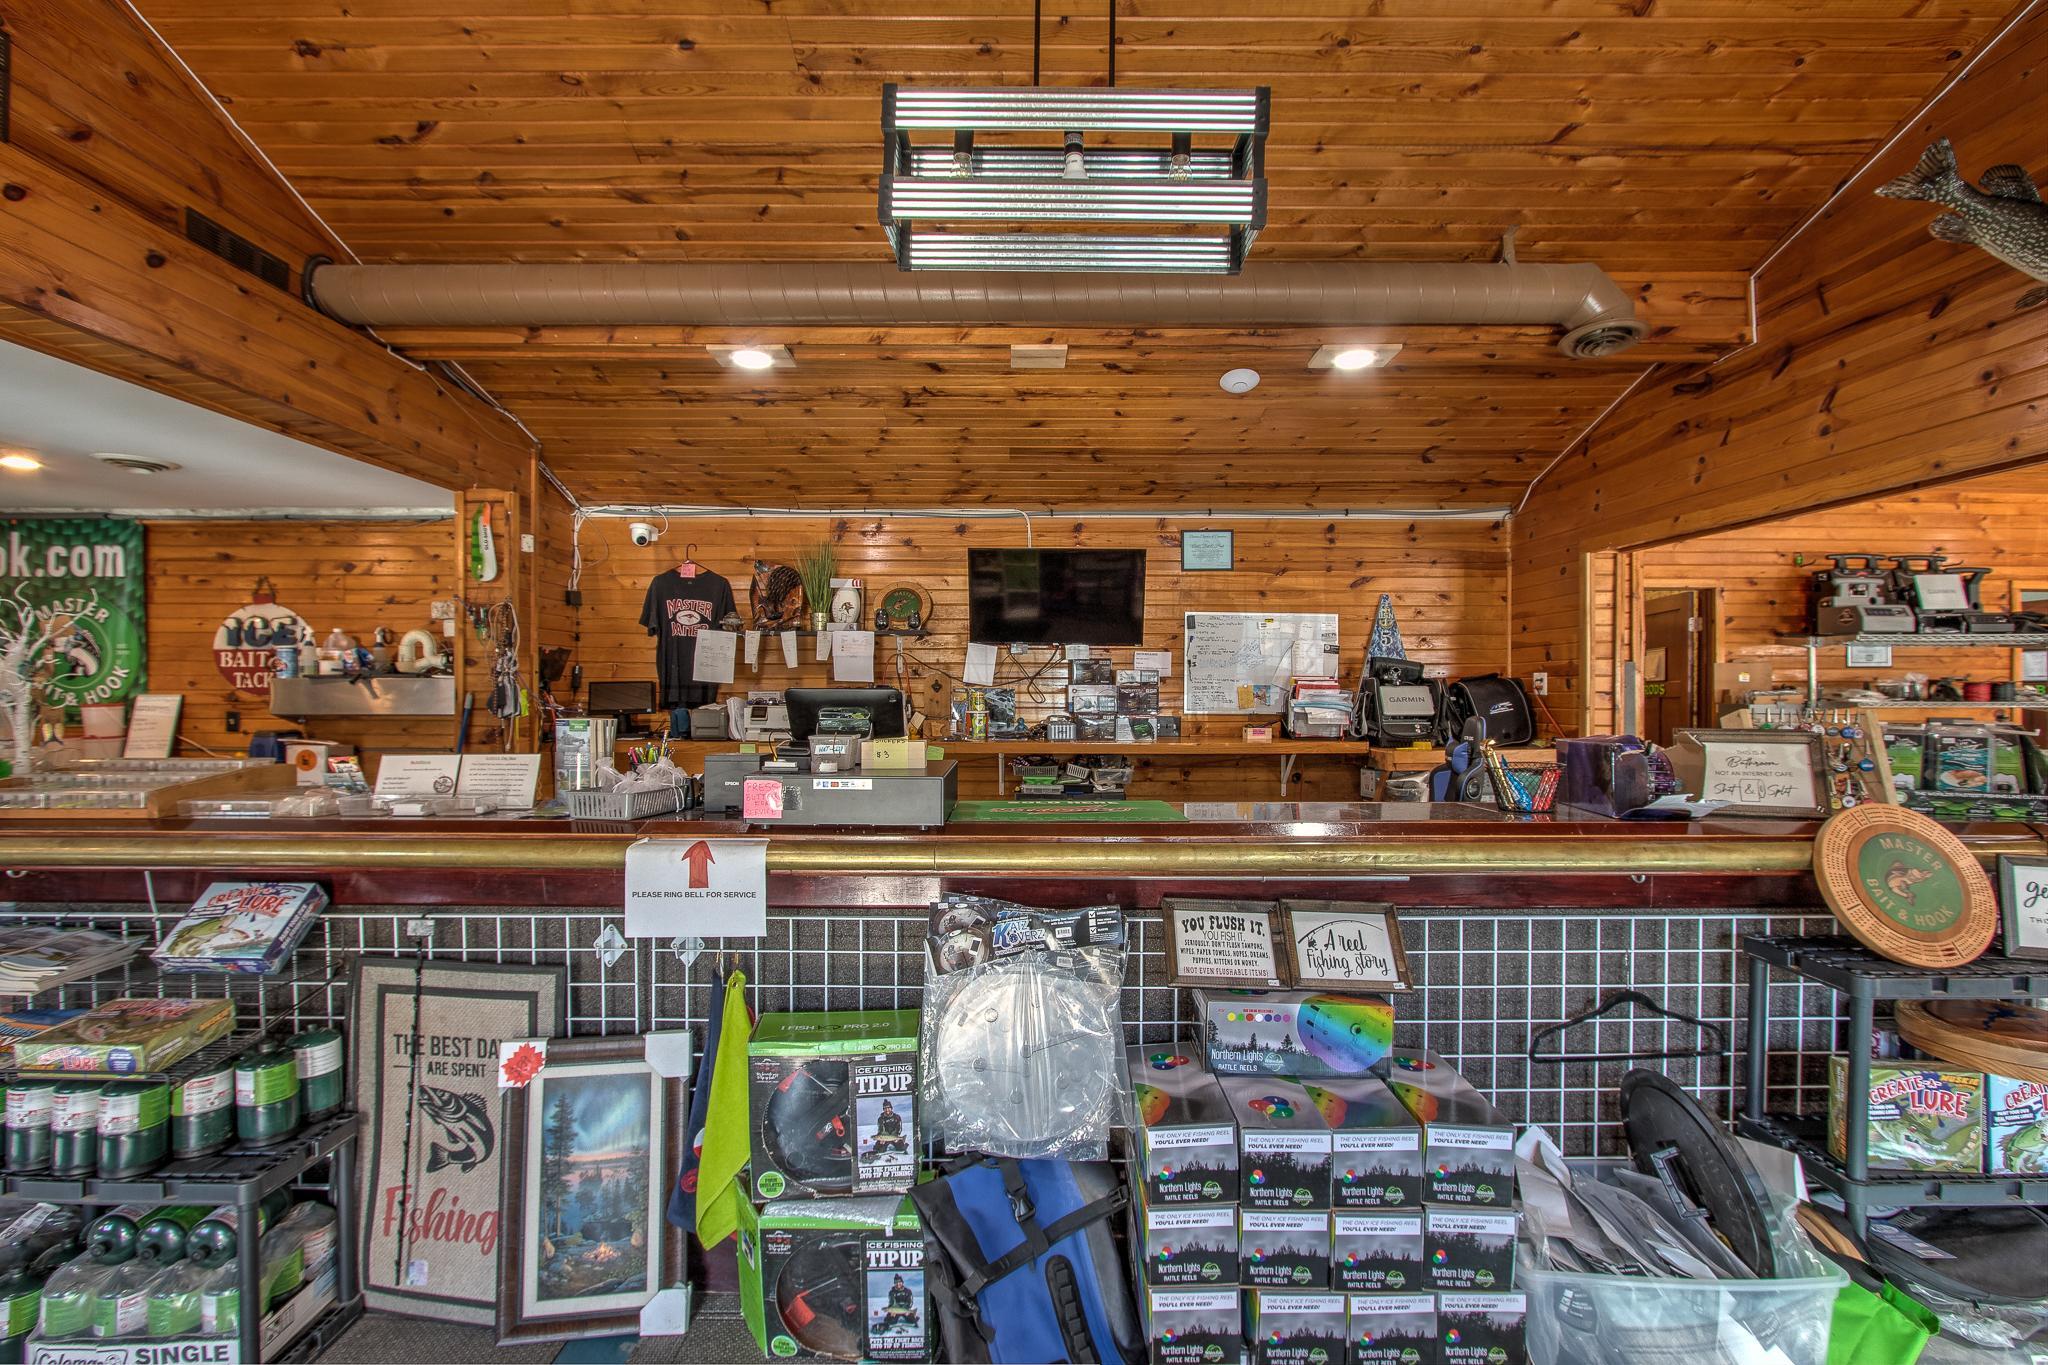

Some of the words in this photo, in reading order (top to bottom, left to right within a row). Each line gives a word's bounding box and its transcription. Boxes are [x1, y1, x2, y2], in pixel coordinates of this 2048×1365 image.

[35, 598, 109, 623] MASTER
[666, 599, 712, 621] MASTER
[224, 616, 297, 647] ICE
[1381, 629, 1392, 646] 5
[220, 651, 270, 668] BAIT
[84, 666, 130, 704] HOOK
[1726, 756, 1779, 768] Bathroom
[1714, 783, 1740, 795] Shit
[1744, 784, 1754, 794] &
[1768, 785, 1799, 797] Split
[1880, 838, 1943, 871] MASTER
[237, 896, 289, 914] LURE
[1866, 878, 1896, 910] BAIT
[1898, 910, 1908, 921] &
[1914, 906, 1954, 926] HOOK
[1182, 916, 1204, 933] YOU
[1209, 915, 1246, 932] FLUSH
[1250, 920, 1265, 937] IT.
[1202, 931, 1219, 941] YOU
[1220, 932, 1236, 942] FISH
[1238, 933, 1246, 942] IT.
[1324, 929, 1336, 951] A
[1338, 930, 1368, 952] reel
[1212, 940, 1226, 948] DON'T
[1196, 948, 1212, 956] PAPER
[1214, 958, 1232, 966] KITTENS
[1306, 948, 1353, 978] Fishing
[1354, 952, 1391, 976] story
[1184, 966, 1198, 974] (NOT
[1200, 966, 1214, 974] EVEN
[1216, 968, 1248, 976] FLUSHABLE
[1250, 969, 1268, 977] ITEMS)
[393, 1034, 425, 1056] THE
[430, 1036, 472, 1058] BEST
[477, 1038, 502, 1060] DA
[1212, 1049, 1240, 1060] Northern
[1243, 1050, 1264, 1064] Lights
[427, 1062, 448, 1076] ARE
[452, 1063, 486, 1078] SPENT
[874, 1065, 912, 1073] FISHING
[1941, 1074, 1979, 1086] MUSKIE
[1910, 1090, 1970, 1118] LURE
[1159, 1182, 1184, 1193] Northern
[1184, 1182, 1201, 1193] Lights
[1250, 1188, 1274, 1197] Northern
[1275, 1188, 1293, 1199] Lights
[1342, 1186, 1366, 1197] Northern
[1367, 1186, 1384, 1197] Lights
[1433, 1182, 1458, 1193] Northern
[1458, 1183, 1476, 1195] Lights
[384, 1184, 499, 1256] Fishing
[1158, 1264, 1183, 1274] Northern
[1183, 1263, 1201, 1275] Lights
[1250, 1265, 1274, 1275] Northern
[1274, 1266, 1292, 1277] Lights
[1343, 1270, 1367, 1280] Northern
[1368, 1270, 1385, 1281] Lights
[1432, 1268, 1457, 1278] Northern
[1457, 1268, 1475, 1279] Lights
[134, 1344, 228, 1364] SINGLE
[1359, 1350, 1383, 1359] Northern
[1383, 1350, 1400, 1360] Lights
[1446, 1347, 1470, 1357] Northern
[1471, 1347, 1487, 1358] Lights
